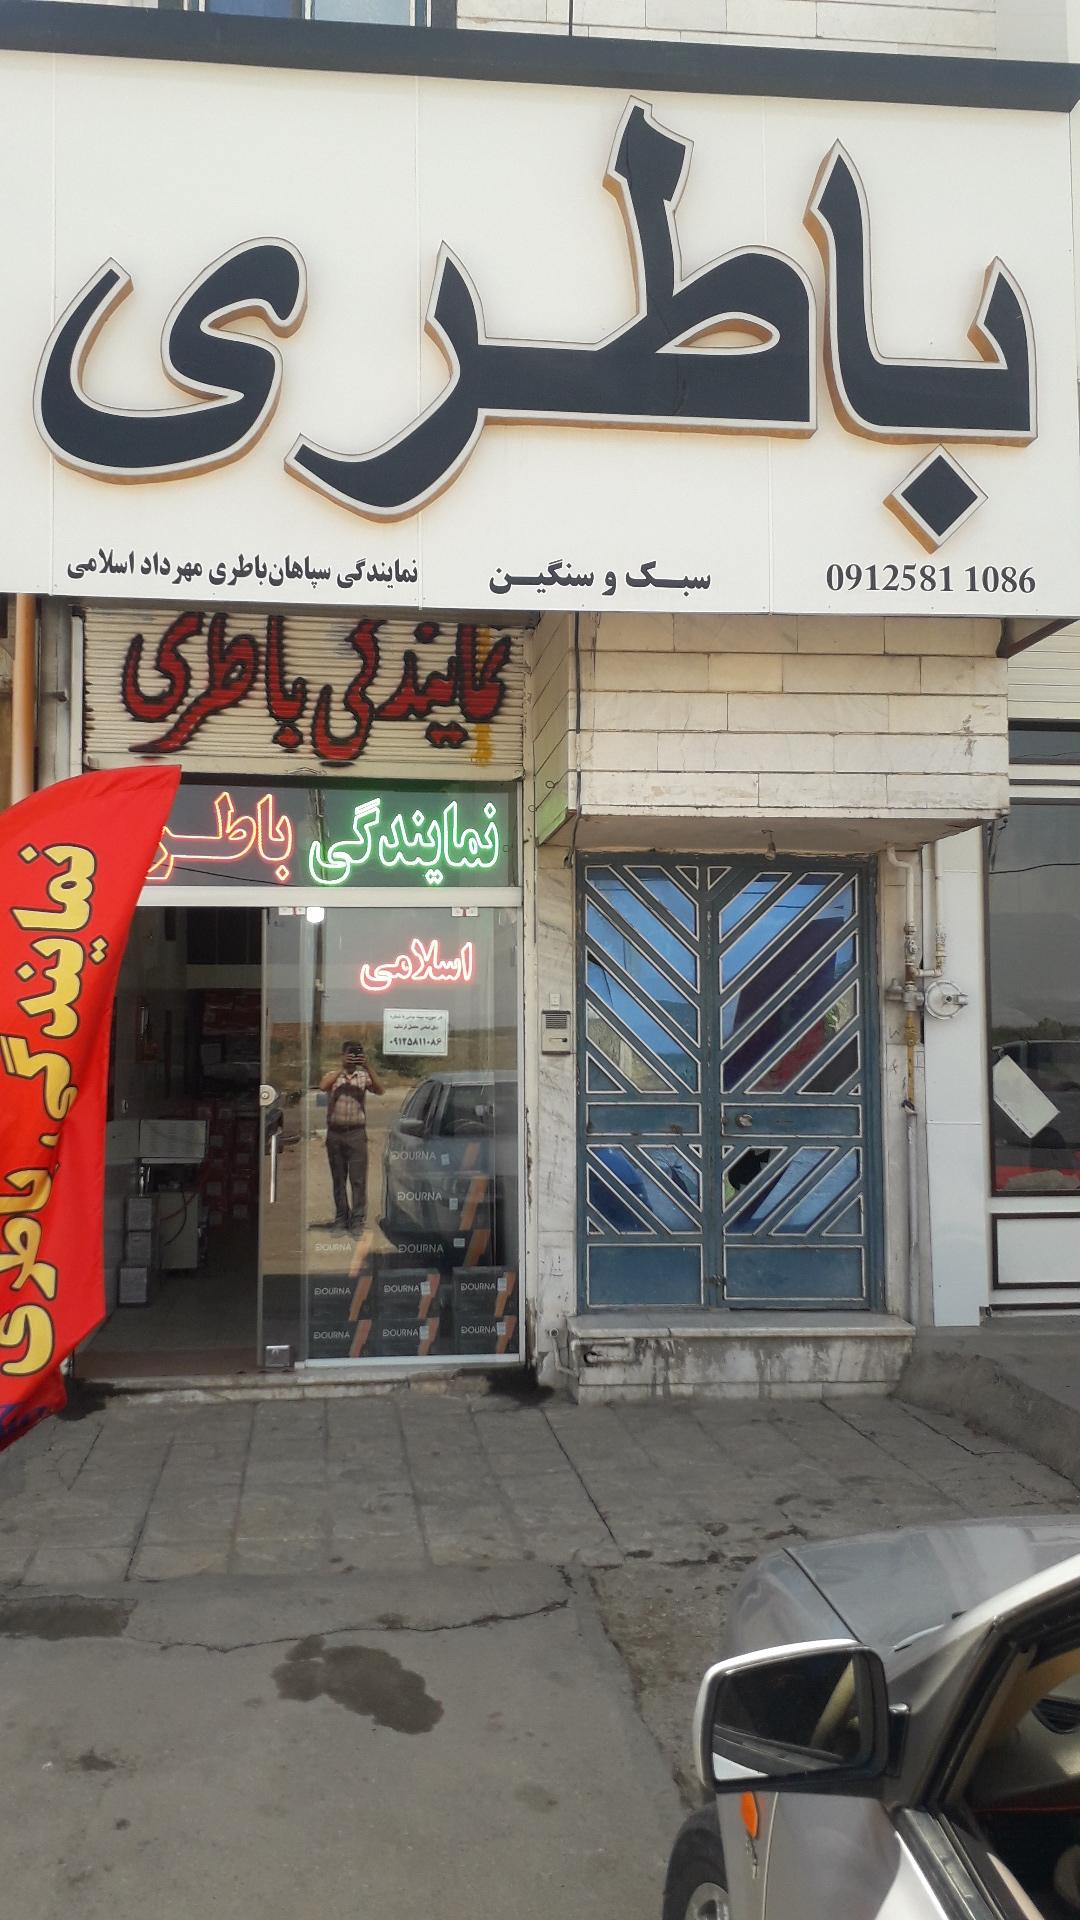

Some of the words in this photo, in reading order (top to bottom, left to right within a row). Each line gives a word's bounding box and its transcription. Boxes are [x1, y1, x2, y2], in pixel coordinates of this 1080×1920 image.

[32, 95, 1039, 555] باطری
[67, 547, 135, 579] اسلامی
[140, 551, 203, 585] مهرداد
[208, 553, 268, 586] باطری
[268, 554, 331, 589] سپاهان
[337, 557, 419, 589] نمایندگی
[489, 558, 595, 595] سنگین
[625, 560, 711, 597] سبک
[601, 570, 617, 596] و
[121, 611, 308, 753] باطری
[144, 790, 294, 882] باطر
[308, 797, 502, 886] نمایندگی
[360, 938, 473, 992] اسلامی
